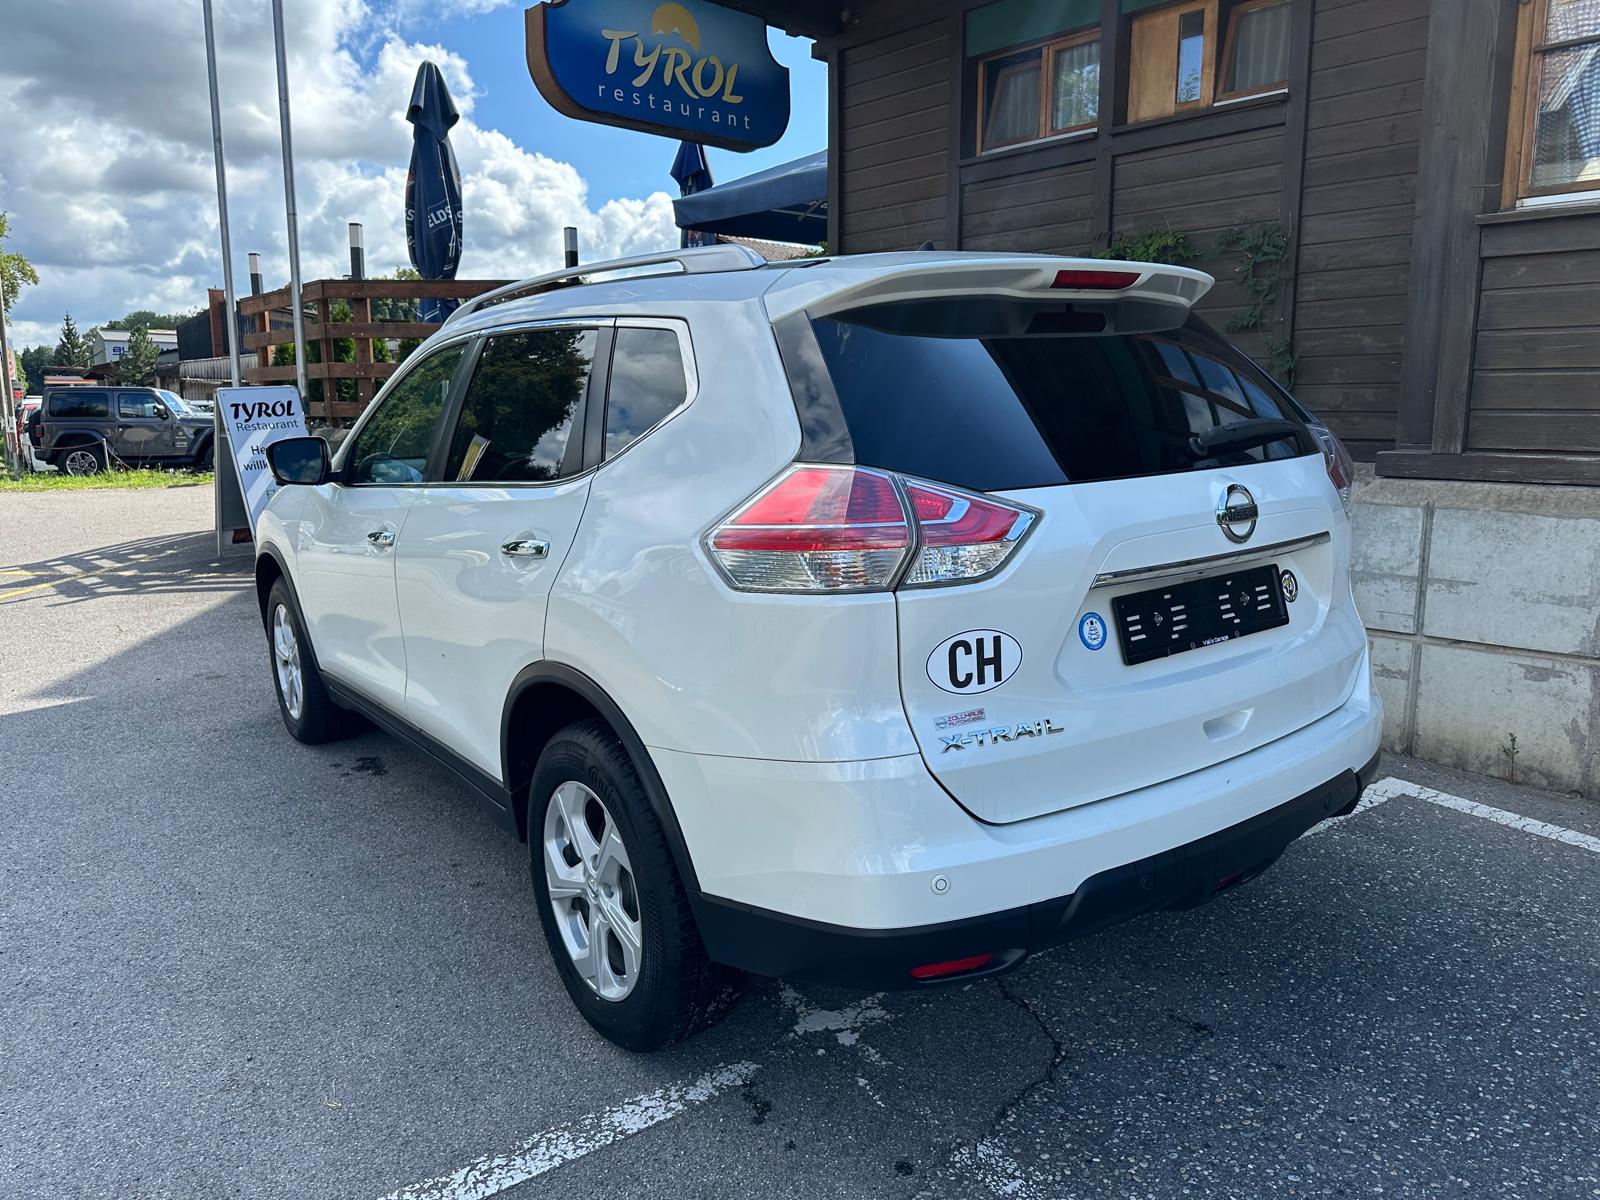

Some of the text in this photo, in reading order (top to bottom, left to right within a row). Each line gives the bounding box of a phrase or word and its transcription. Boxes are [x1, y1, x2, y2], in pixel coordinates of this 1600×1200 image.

[601, 29, 744, 104] TYROL
[598, 83, 751, 130] restaurant
[230, 399, 296, 423] TYROL
[236, 419, 300, 432] Restaurant
[251, 445, 267, 456] He
[243, 460, 269, 472] willk
[948, 634, 1003, 689] CH
[947, 708, 985, 722] ZOLLHAUS
[938, 718, 1065, 754] X-TRAIL
